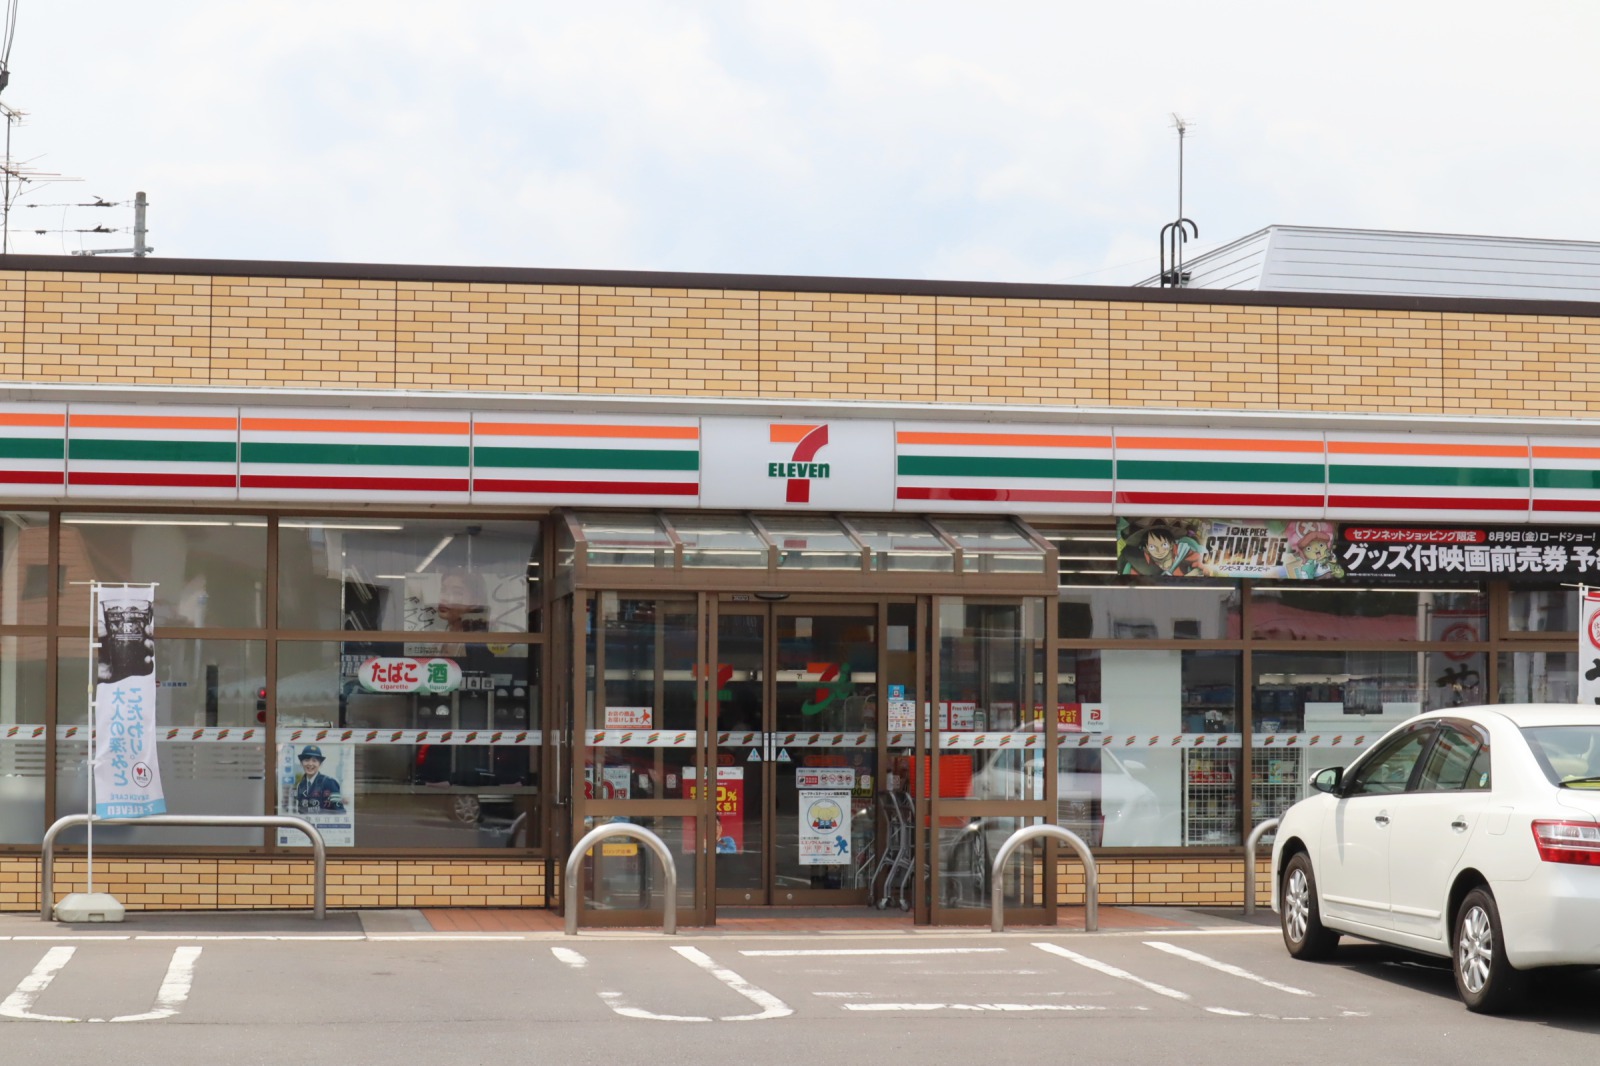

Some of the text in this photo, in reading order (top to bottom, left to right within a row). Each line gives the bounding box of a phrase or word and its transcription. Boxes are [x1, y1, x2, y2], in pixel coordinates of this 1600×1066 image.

[770, 424, 828, 503] 7
[1250, 528, 1269, 537] PIECE
[1353, 529, 1477, 542] セブンネットショッピング限定
[1202, 536, 1288, 567] STAMPEDE
[371, 662, 418, 684] たばこ
[427, 663, 448, 684] 酒
